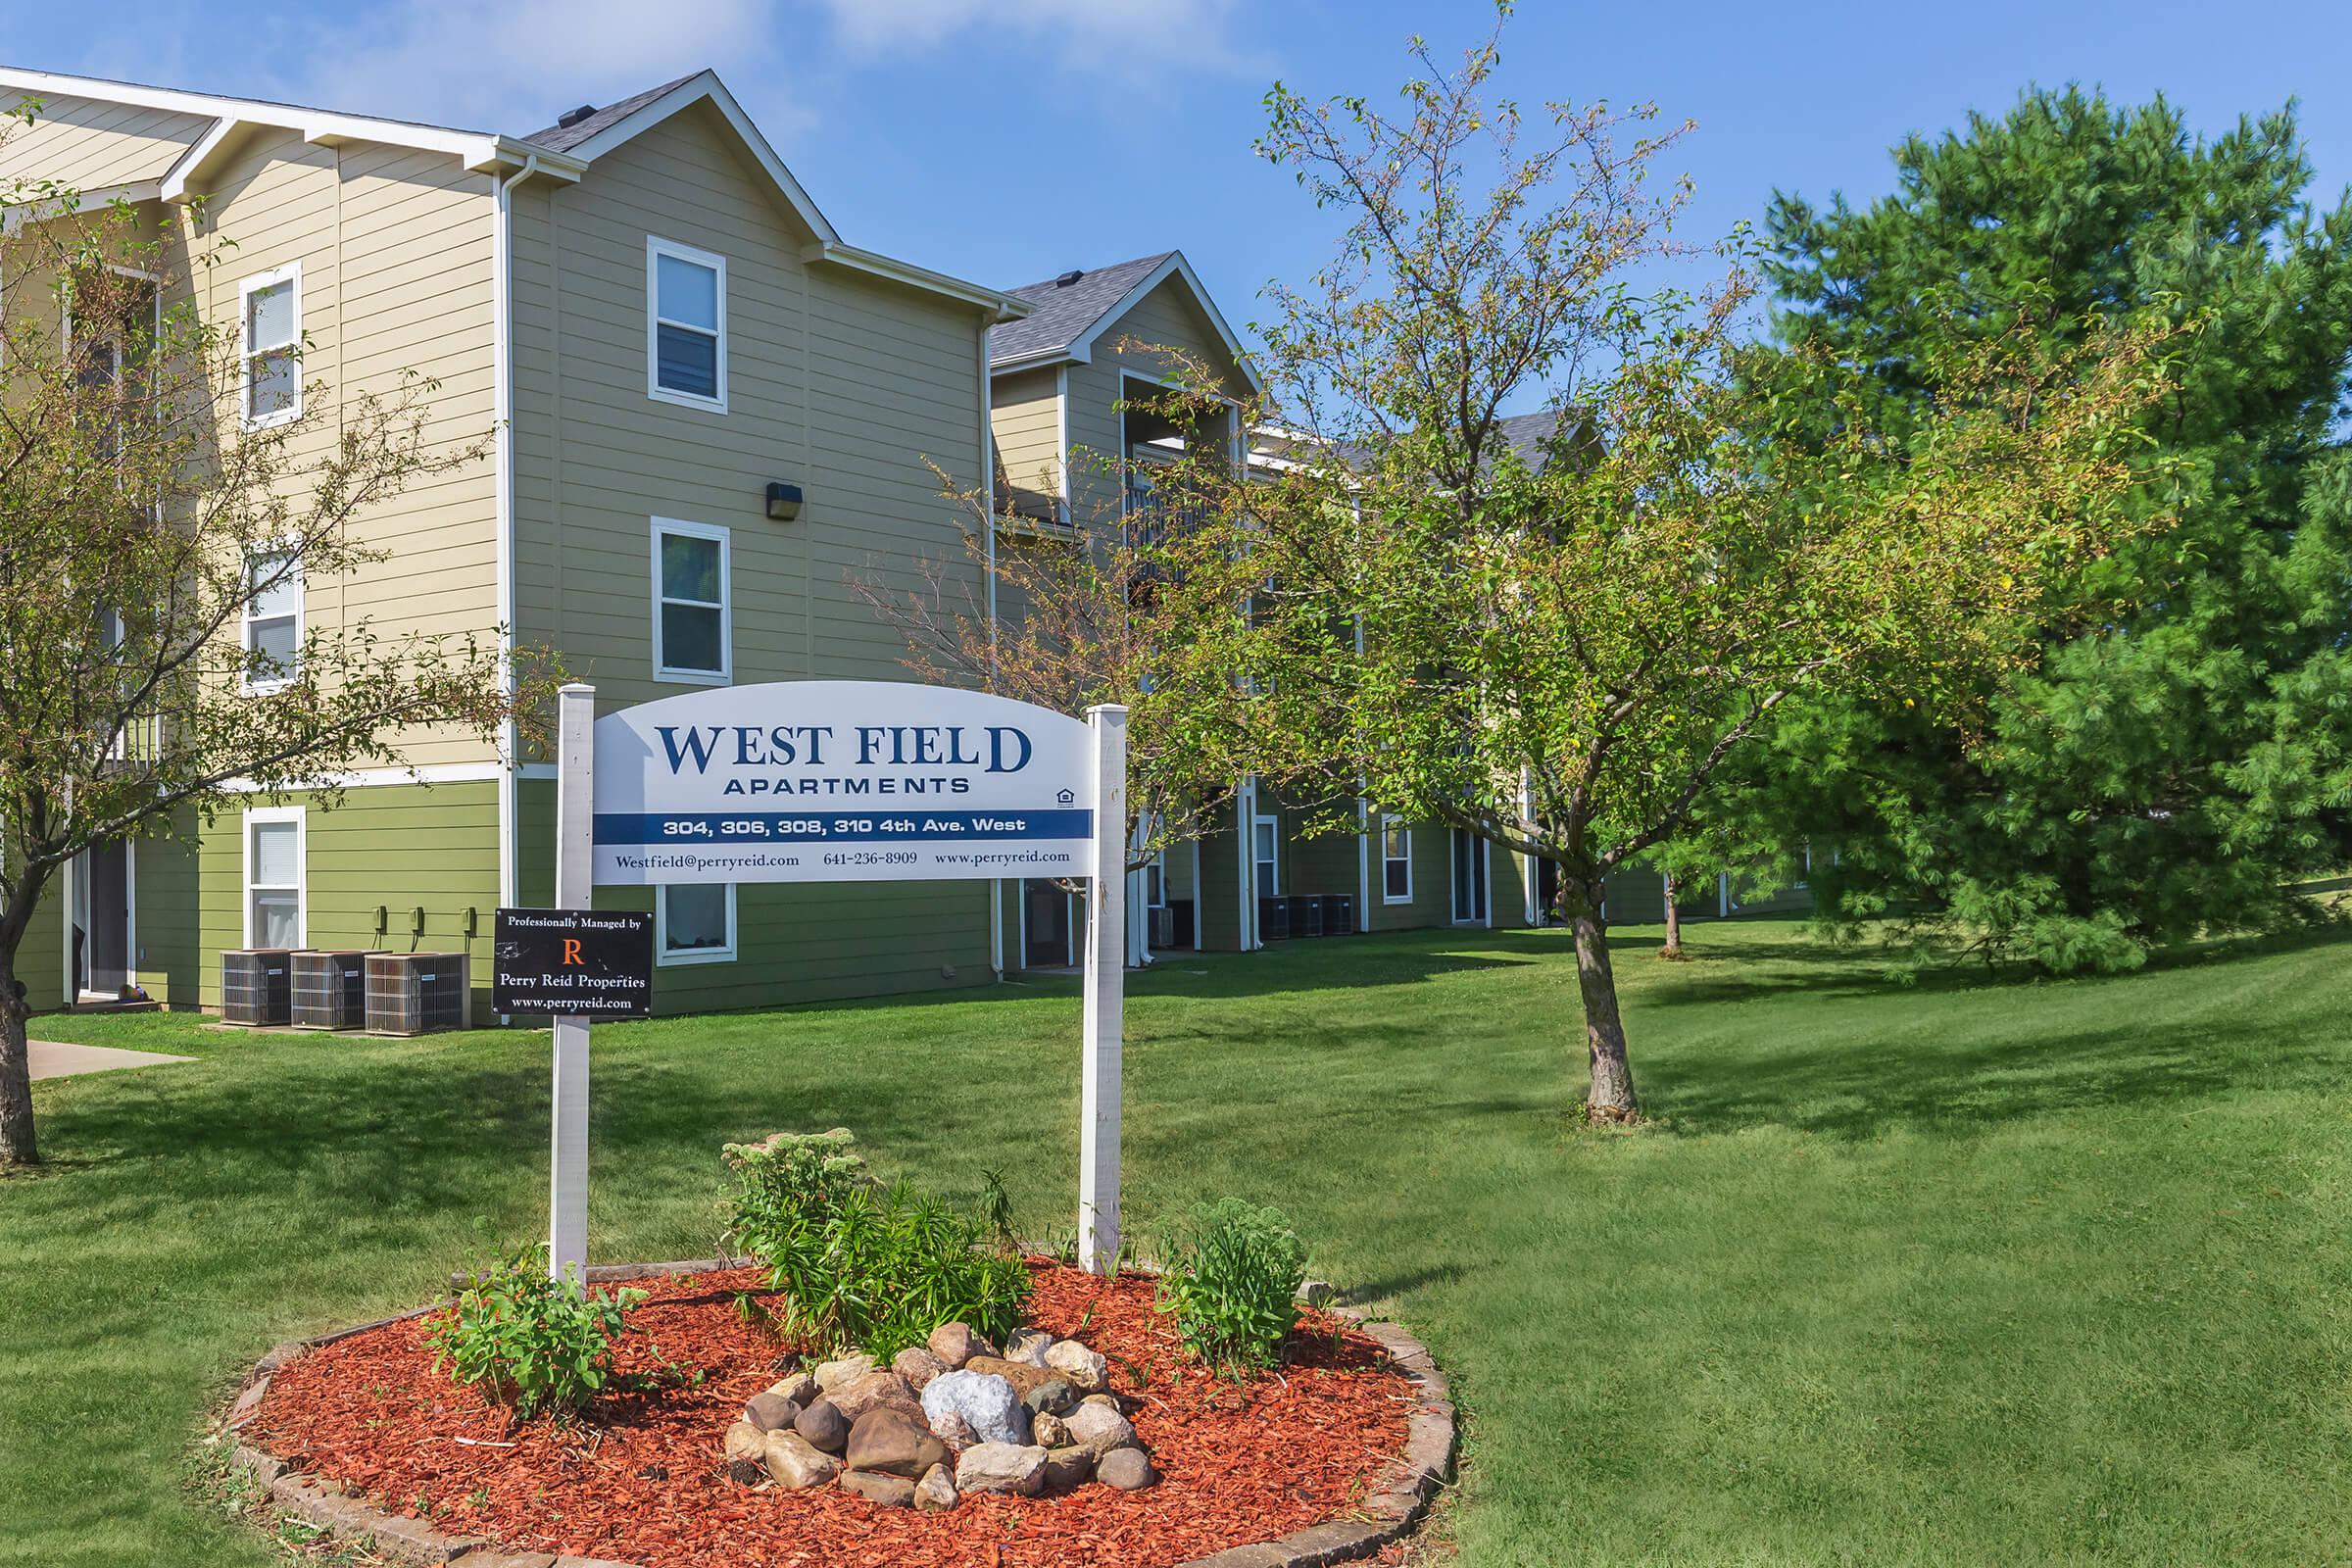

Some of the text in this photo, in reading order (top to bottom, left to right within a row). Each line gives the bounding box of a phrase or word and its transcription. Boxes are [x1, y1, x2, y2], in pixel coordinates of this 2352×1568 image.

[653, 725, 1032, 775] WEST FIELD
[722, 777, 970, 796] APARTMENTS
[662, 818, 1026, 838] 304, 306, 308, 310 4th Ave. West
[615, 855, 800, 871] Westfield@perryreid.com
[823, 852, 917, 865] 641-236-8909
[935, 850, 1070, 868] www.perryreid.com
[508, 916, 641, 930] Professionally Managed by
[563, 938, 585, 965] R
[500, 973, 646, 989] Perry Reid Properties
[512, 997, 632, 1012] www.perryreid.com
